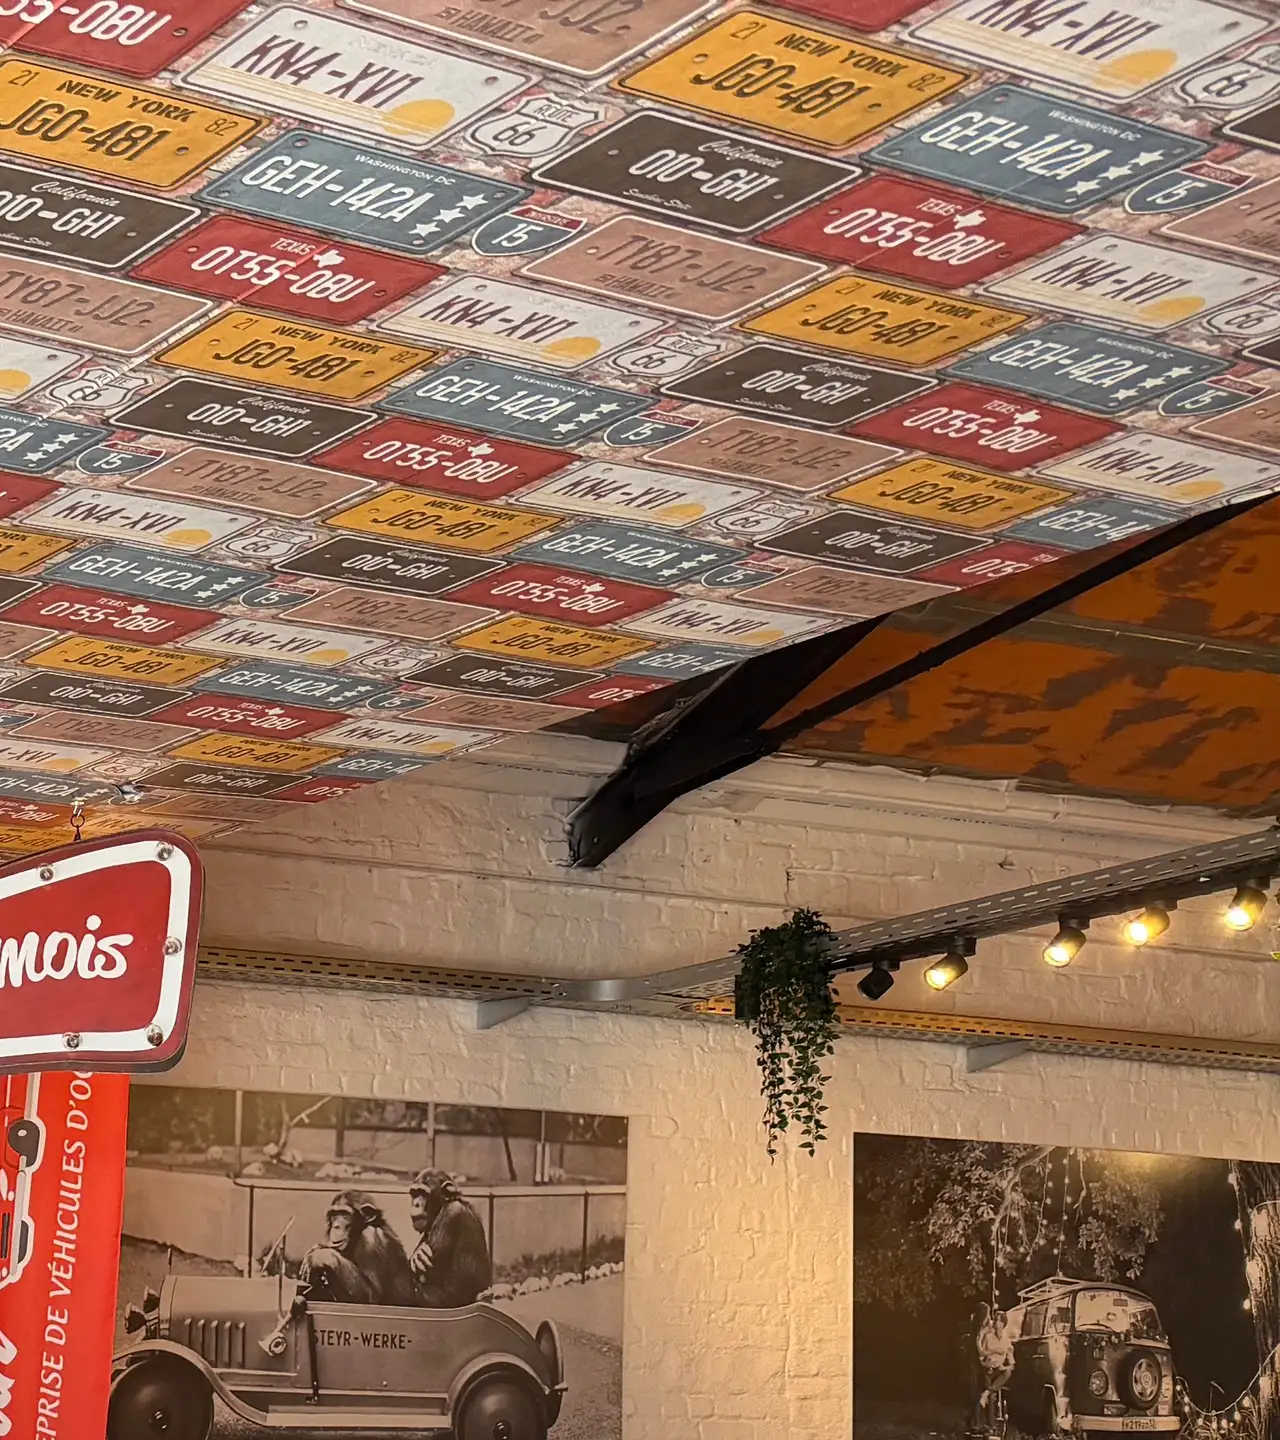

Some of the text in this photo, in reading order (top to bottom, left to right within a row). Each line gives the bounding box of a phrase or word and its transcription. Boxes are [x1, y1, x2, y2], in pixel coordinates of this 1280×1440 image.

[774, 34, 909, 77] NEW YORK
[55, 81, 197, 121] NEW YORK
[697, 140, 782, 167] California
[920, 111, 1115, 179] GEH-142A
[31, 182, 119, 207] California
[241, 156, 435, 219] GEH-142A
[271, 238, 314, 253] TEXAS
[271, 326, 386, 354] NEW YORK
[46, 1138, 87, 1298] VÉHICULES
[46, 1305, 69, 1347] DE
